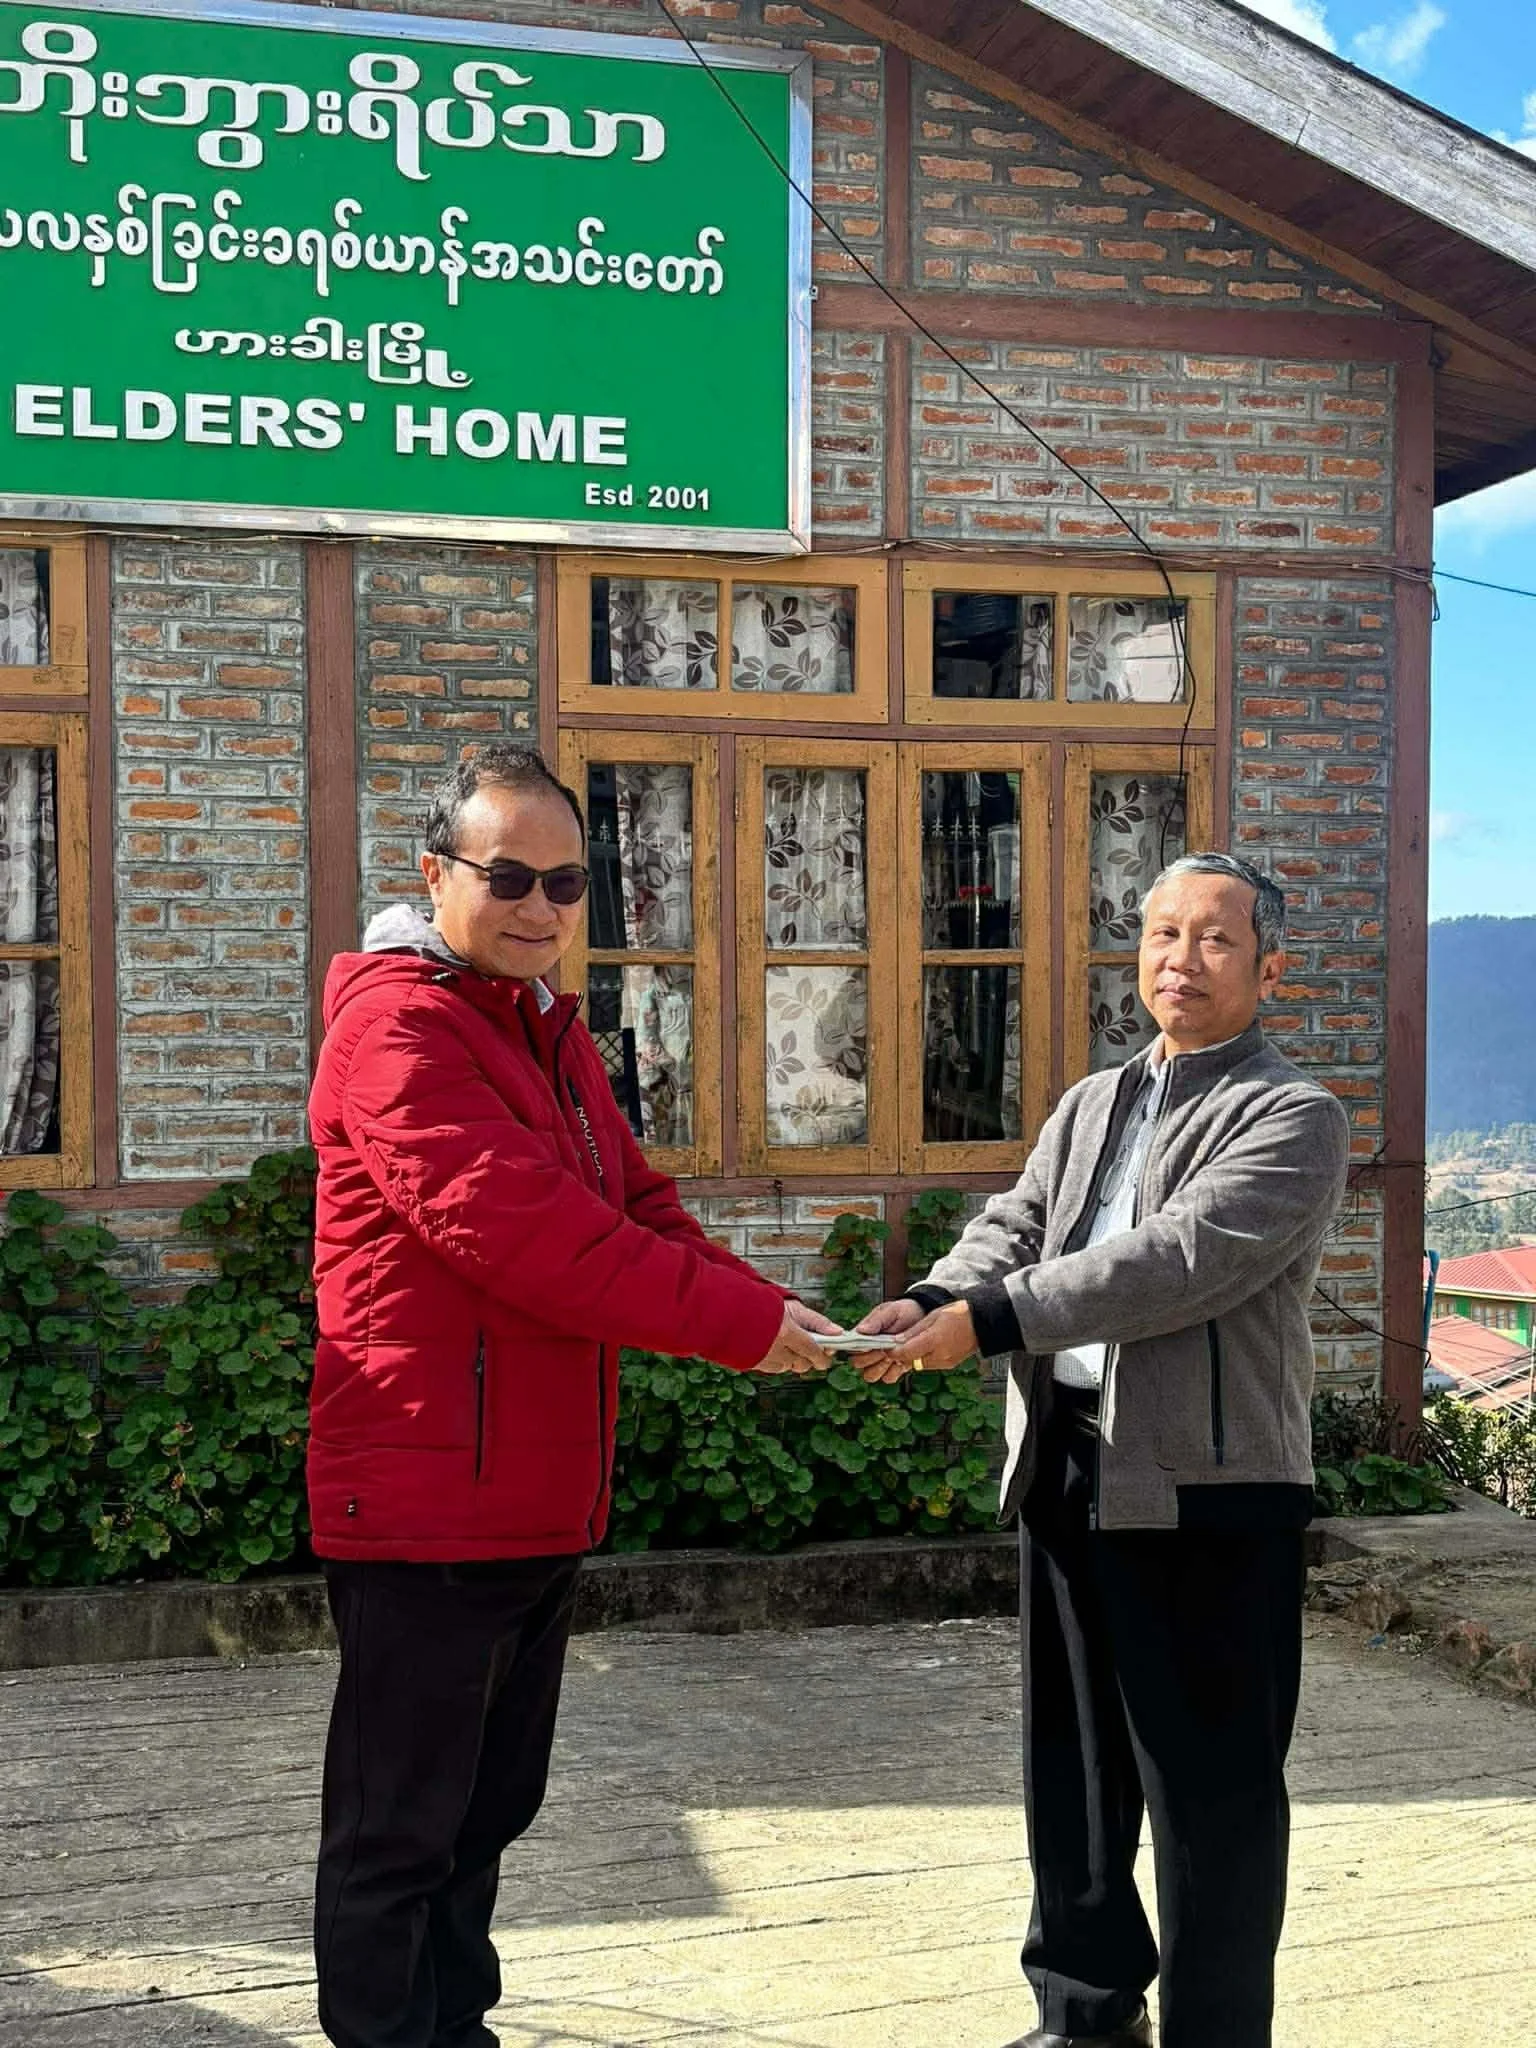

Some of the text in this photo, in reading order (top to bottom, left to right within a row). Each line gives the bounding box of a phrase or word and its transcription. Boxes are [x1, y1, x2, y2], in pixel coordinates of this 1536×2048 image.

[15, 383, 628, 466] ELDERS' HOME
[585, 482, 710, 511] Esd 2001
